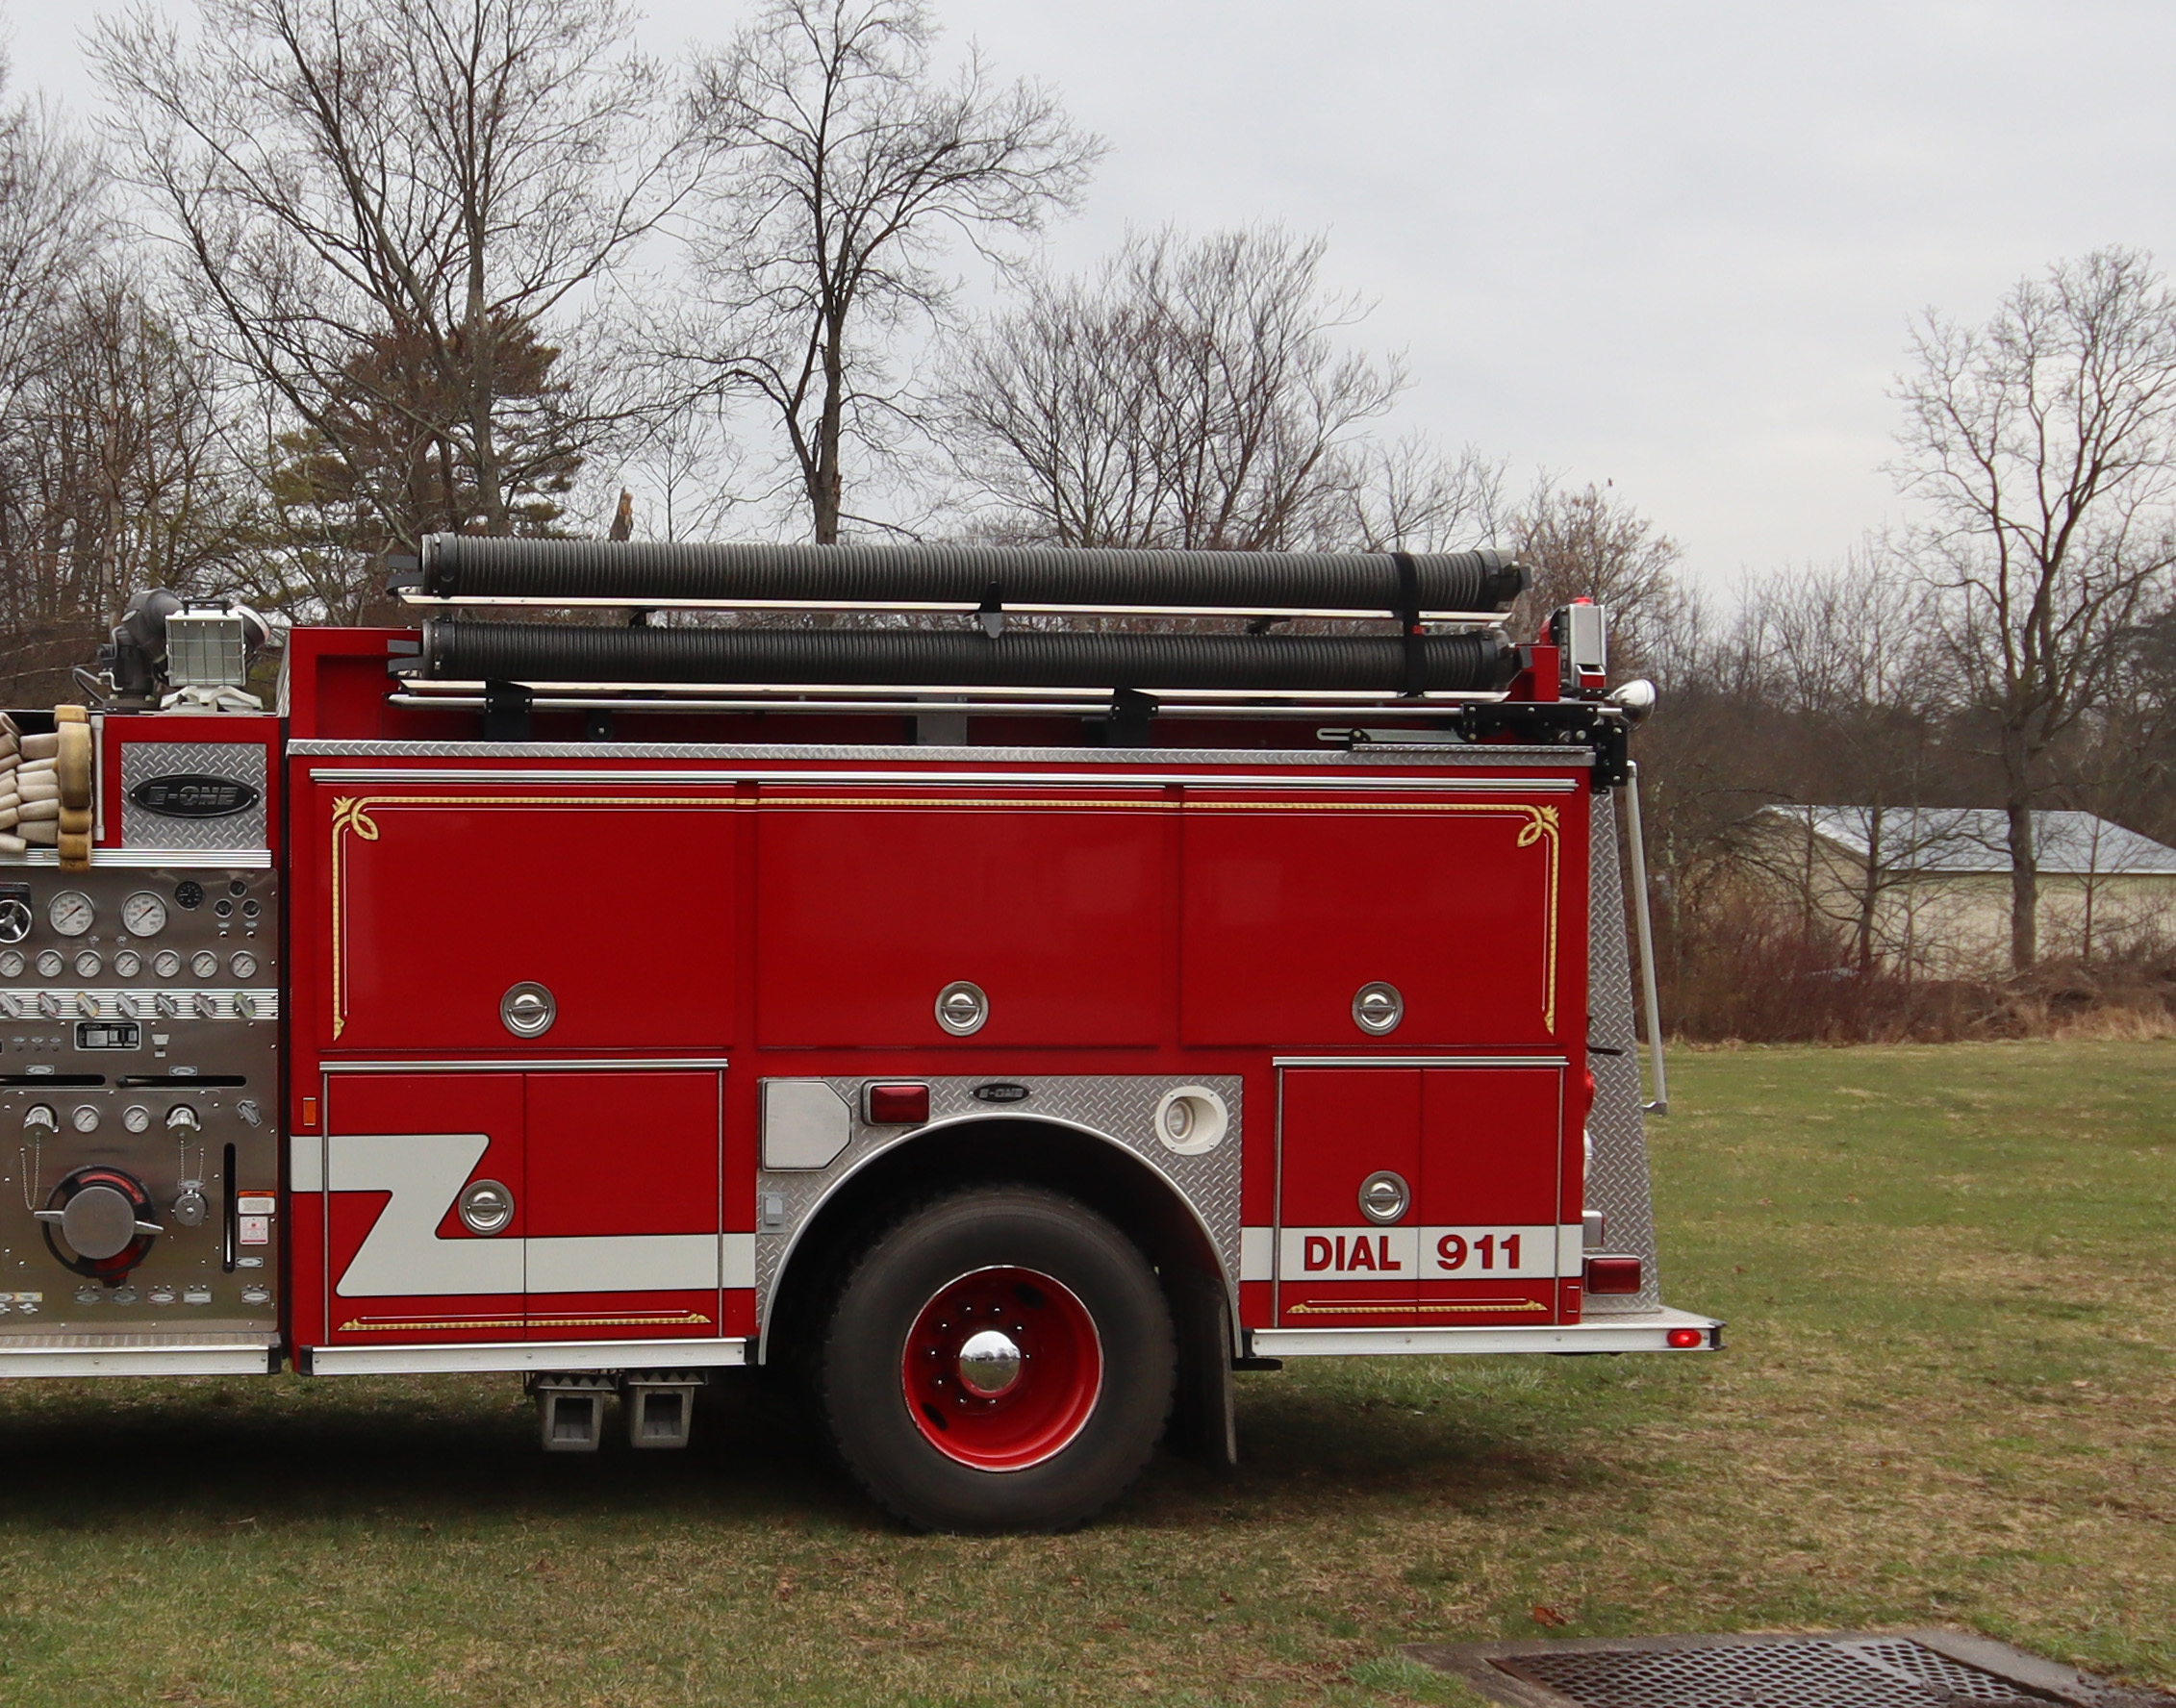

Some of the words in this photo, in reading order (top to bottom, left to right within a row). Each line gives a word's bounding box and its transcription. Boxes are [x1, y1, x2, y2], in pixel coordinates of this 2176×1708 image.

[147, 786, 239, 806] E-ONE
[1303, 1236, 1402, 1271] DIAL
[1436, 1234, 1521, 1270] 911
